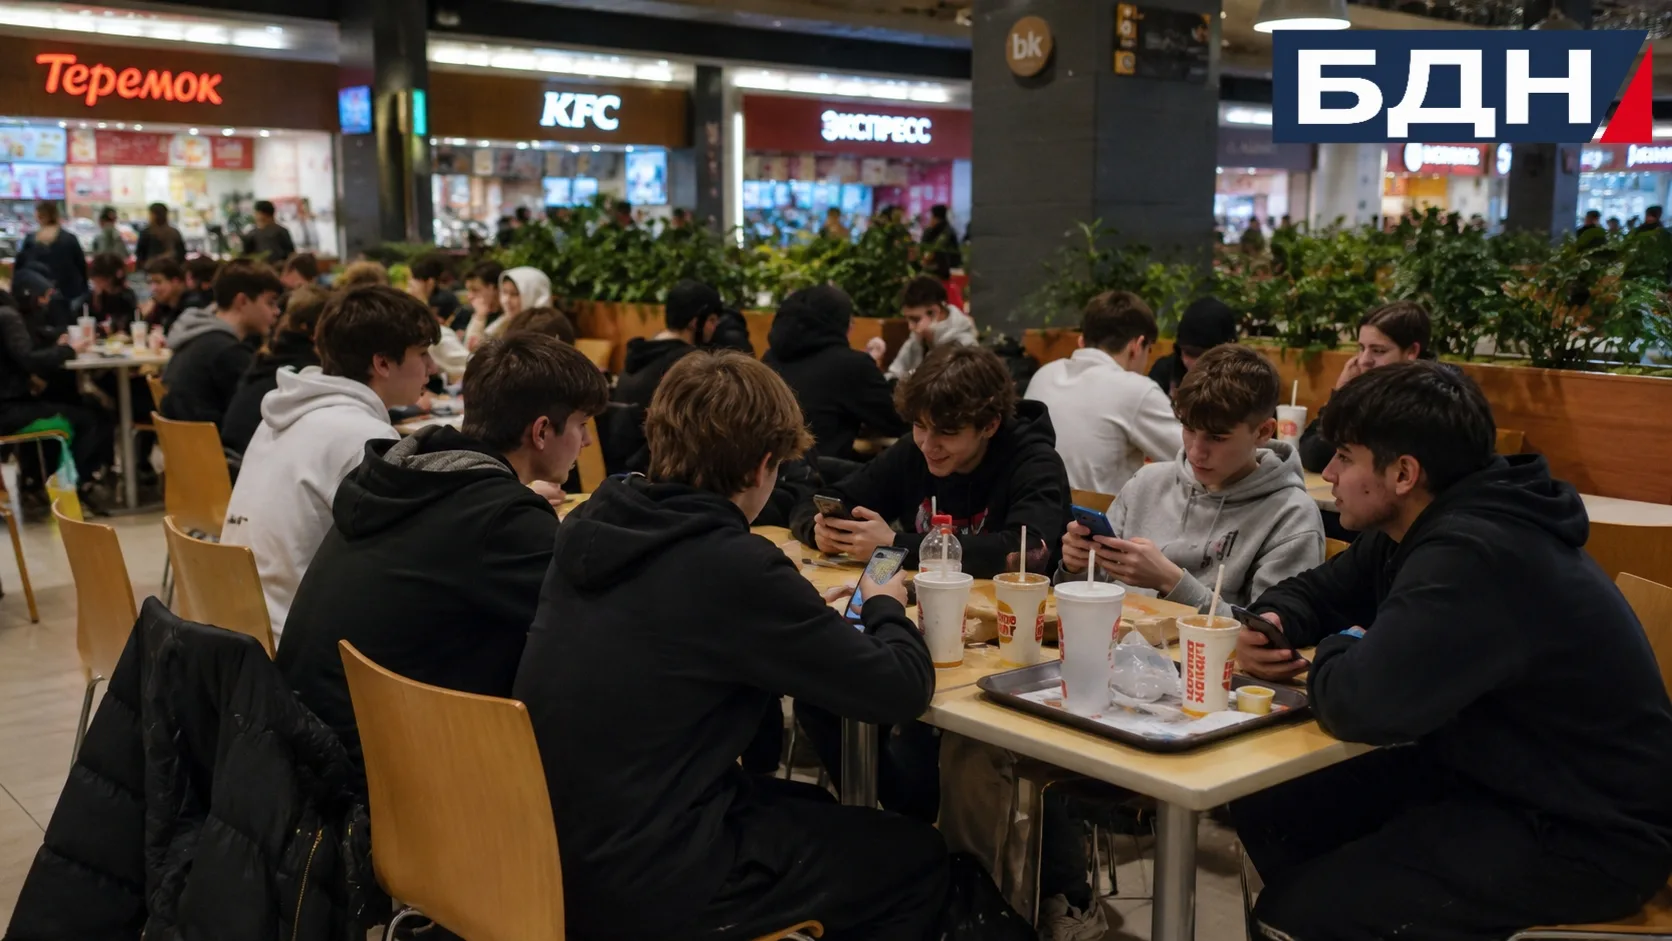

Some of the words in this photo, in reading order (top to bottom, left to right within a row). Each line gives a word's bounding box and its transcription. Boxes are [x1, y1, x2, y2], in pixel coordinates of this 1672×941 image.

[1012, 30, 1043, 60] bk
[36, 53, 223, 106] Теремок
[540, 91, 621, 131] KFC
[820, 109, 932, 145] ЭКСПРЕСС
